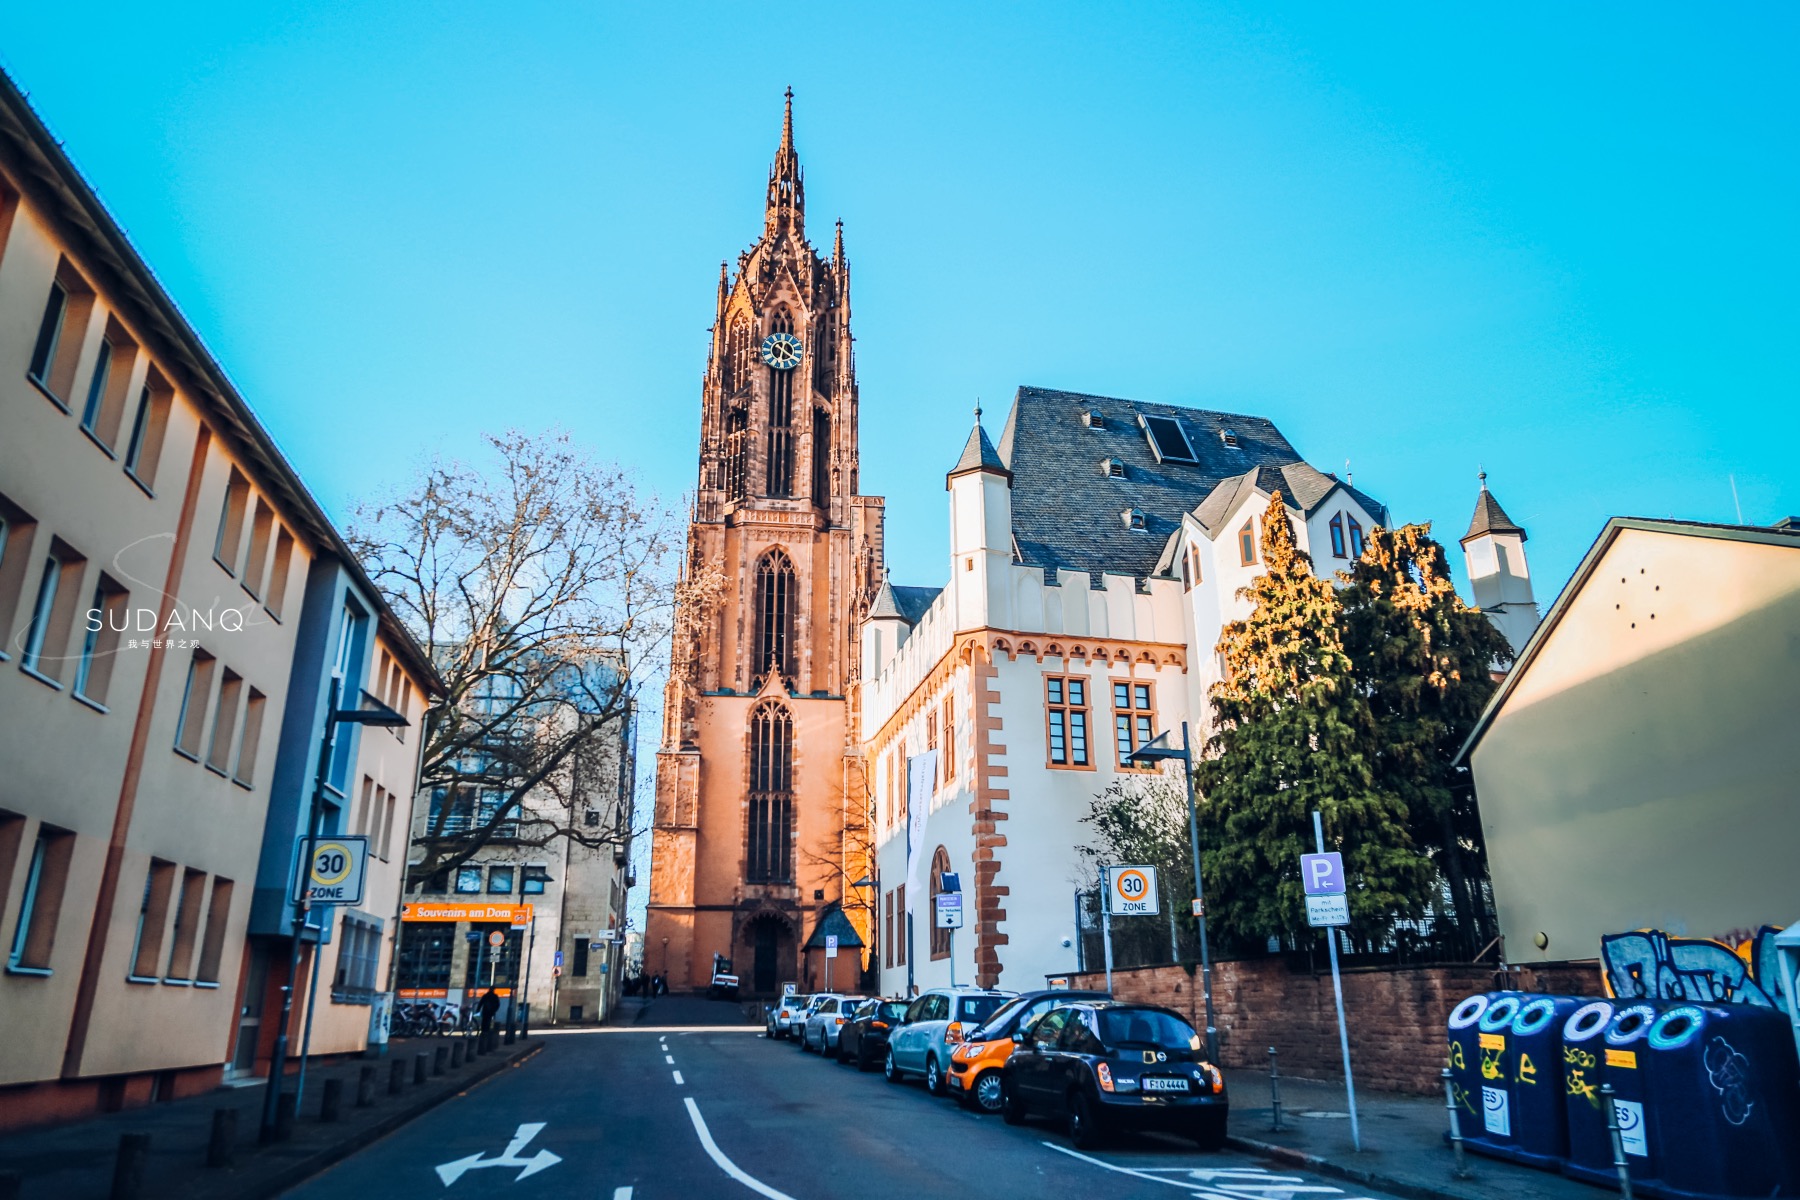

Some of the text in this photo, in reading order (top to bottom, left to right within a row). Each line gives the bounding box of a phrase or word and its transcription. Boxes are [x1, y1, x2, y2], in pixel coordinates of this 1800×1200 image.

[317, 854, 344, 873] 30
[1311, 859, 1333, 889] P
[1123, 878, 1142, 892] 30
[310, 887, 344, 898] ZONE
[417, 907, 512, 918] Souvenirs am Dom
[1122, 903, 1147, 911] ZONE
